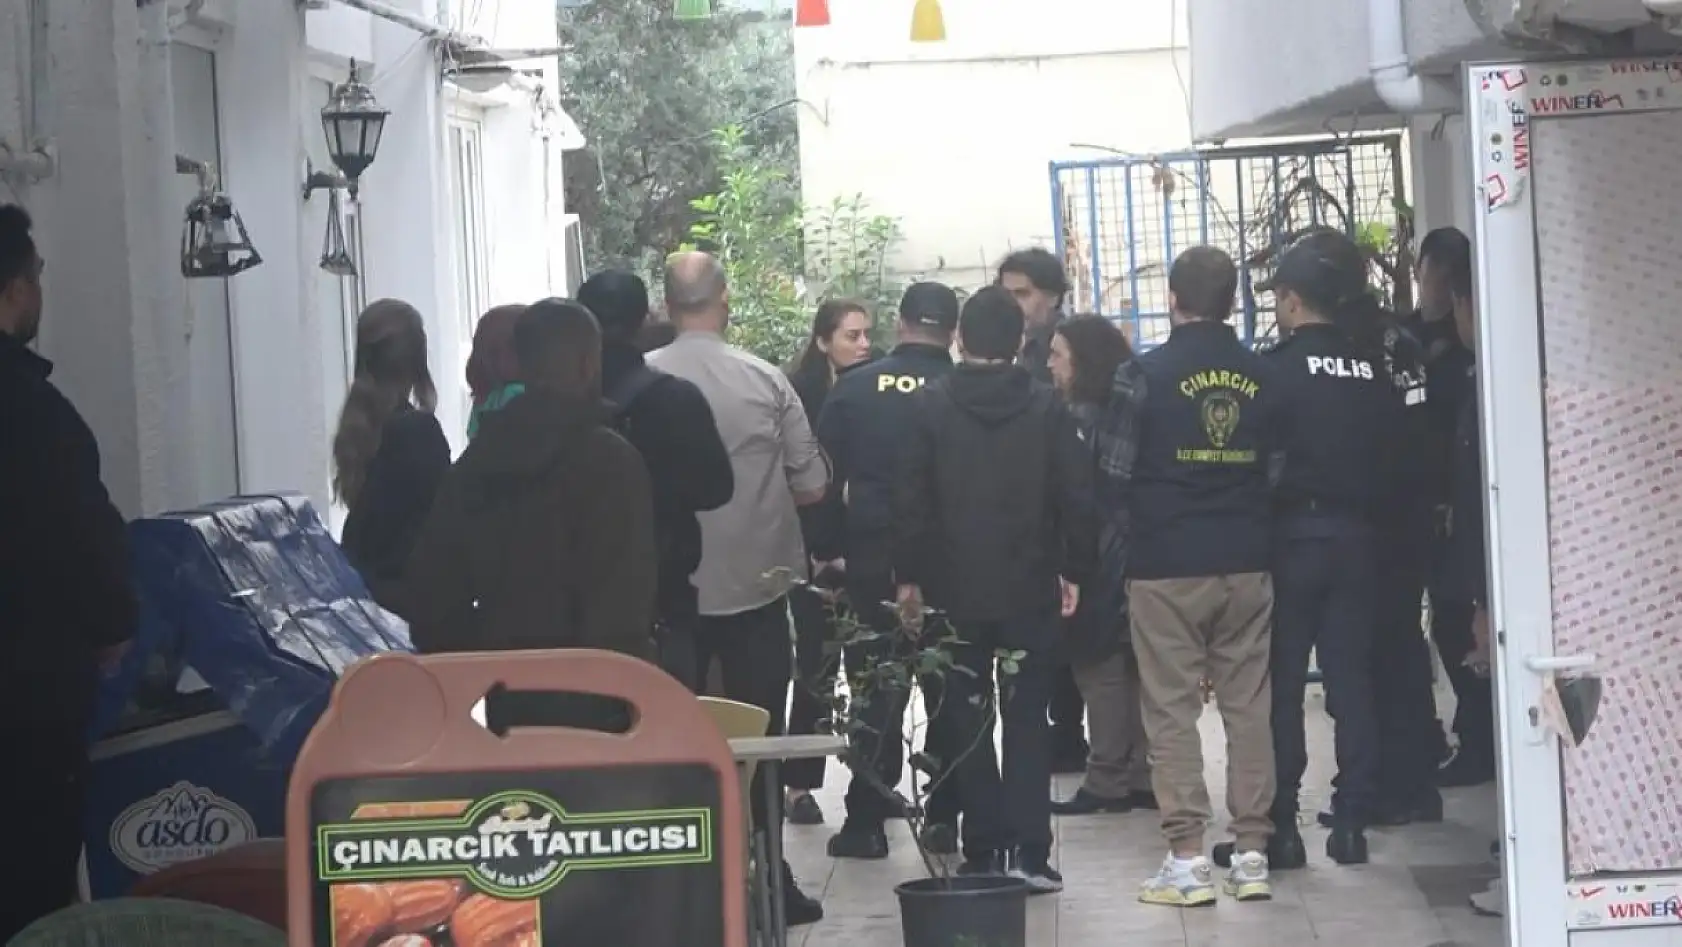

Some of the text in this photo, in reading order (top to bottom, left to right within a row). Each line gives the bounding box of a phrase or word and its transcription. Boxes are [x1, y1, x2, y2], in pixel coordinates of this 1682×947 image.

[136, 804, 230, 848] asdo
[530, 824, 698, 857] TATLICISI
[1607, 899, 1677, 918] WINER
